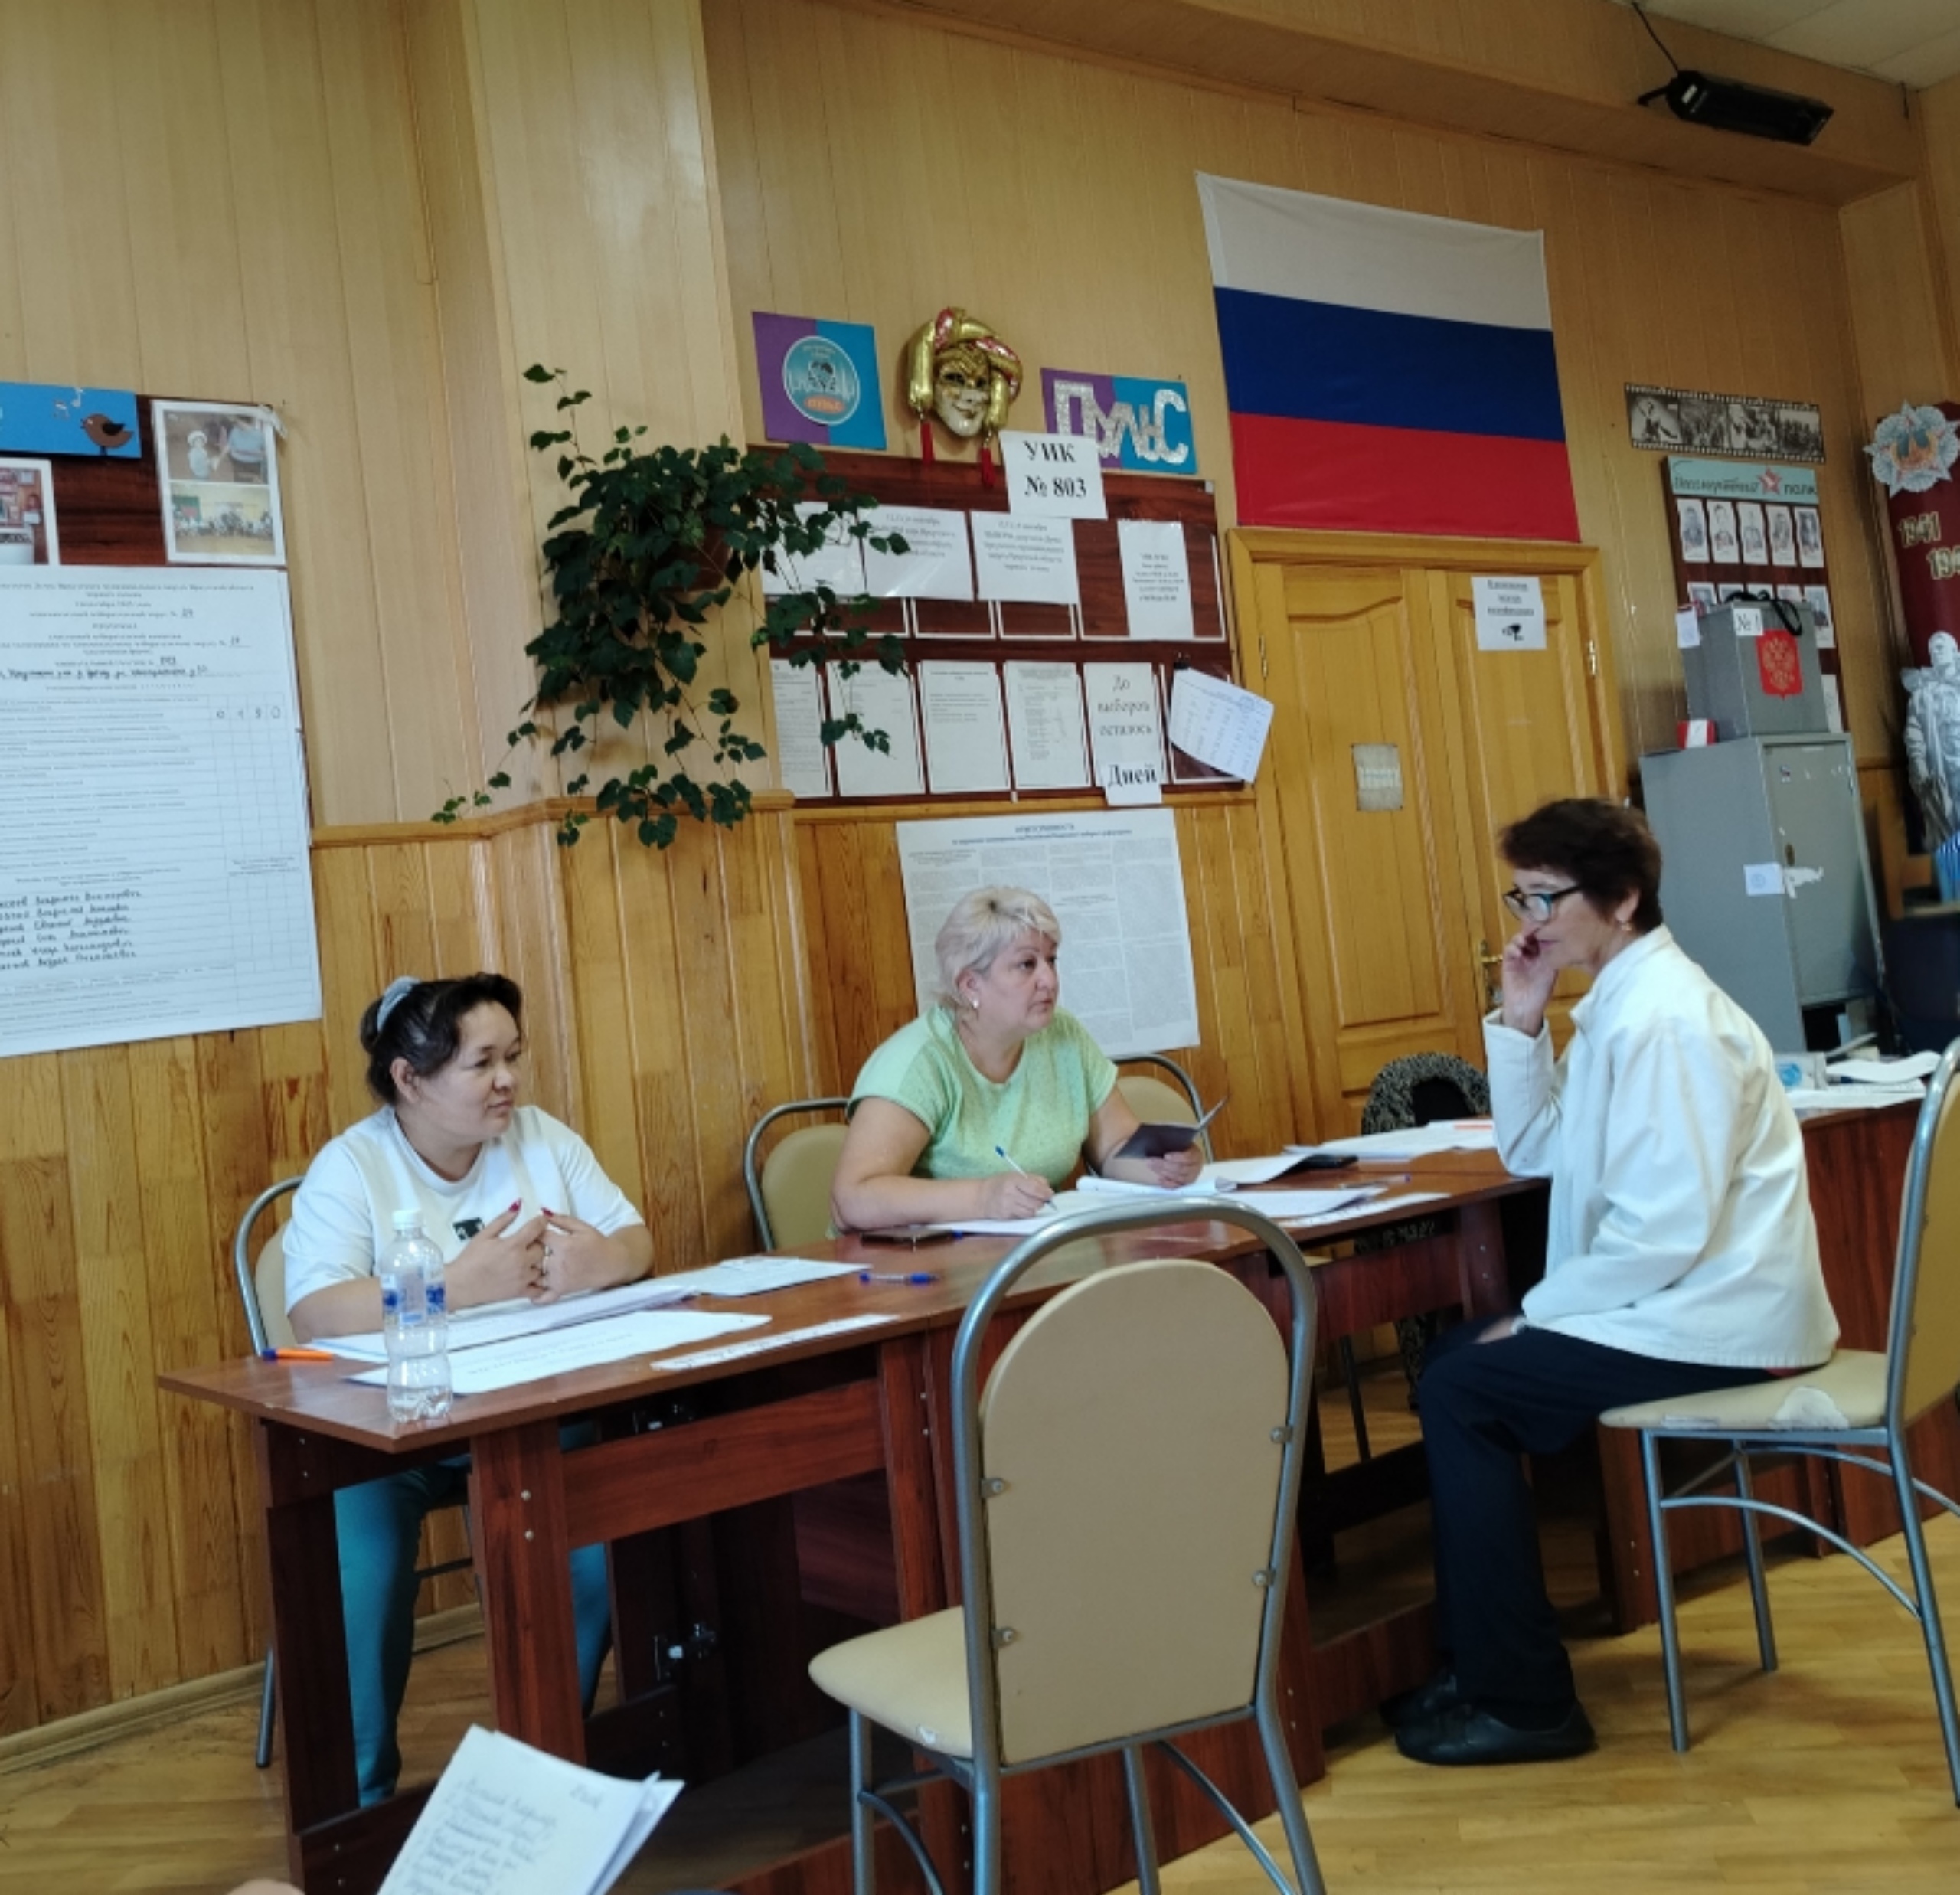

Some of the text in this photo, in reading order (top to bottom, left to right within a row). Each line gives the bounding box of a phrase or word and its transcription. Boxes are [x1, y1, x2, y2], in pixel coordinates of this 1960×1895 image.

[1023, 440, 1076, 462] УИК
[1024, 475, 1087, 498] № 803
[1897, 511, 1942, 548] 1941
[1112, 675, 1130, 691] До
[1097, 700, 1150, 716] выборов
[1099, 725, 1152, 736] осталось
[1108, 763, 1158, 787] Дней
